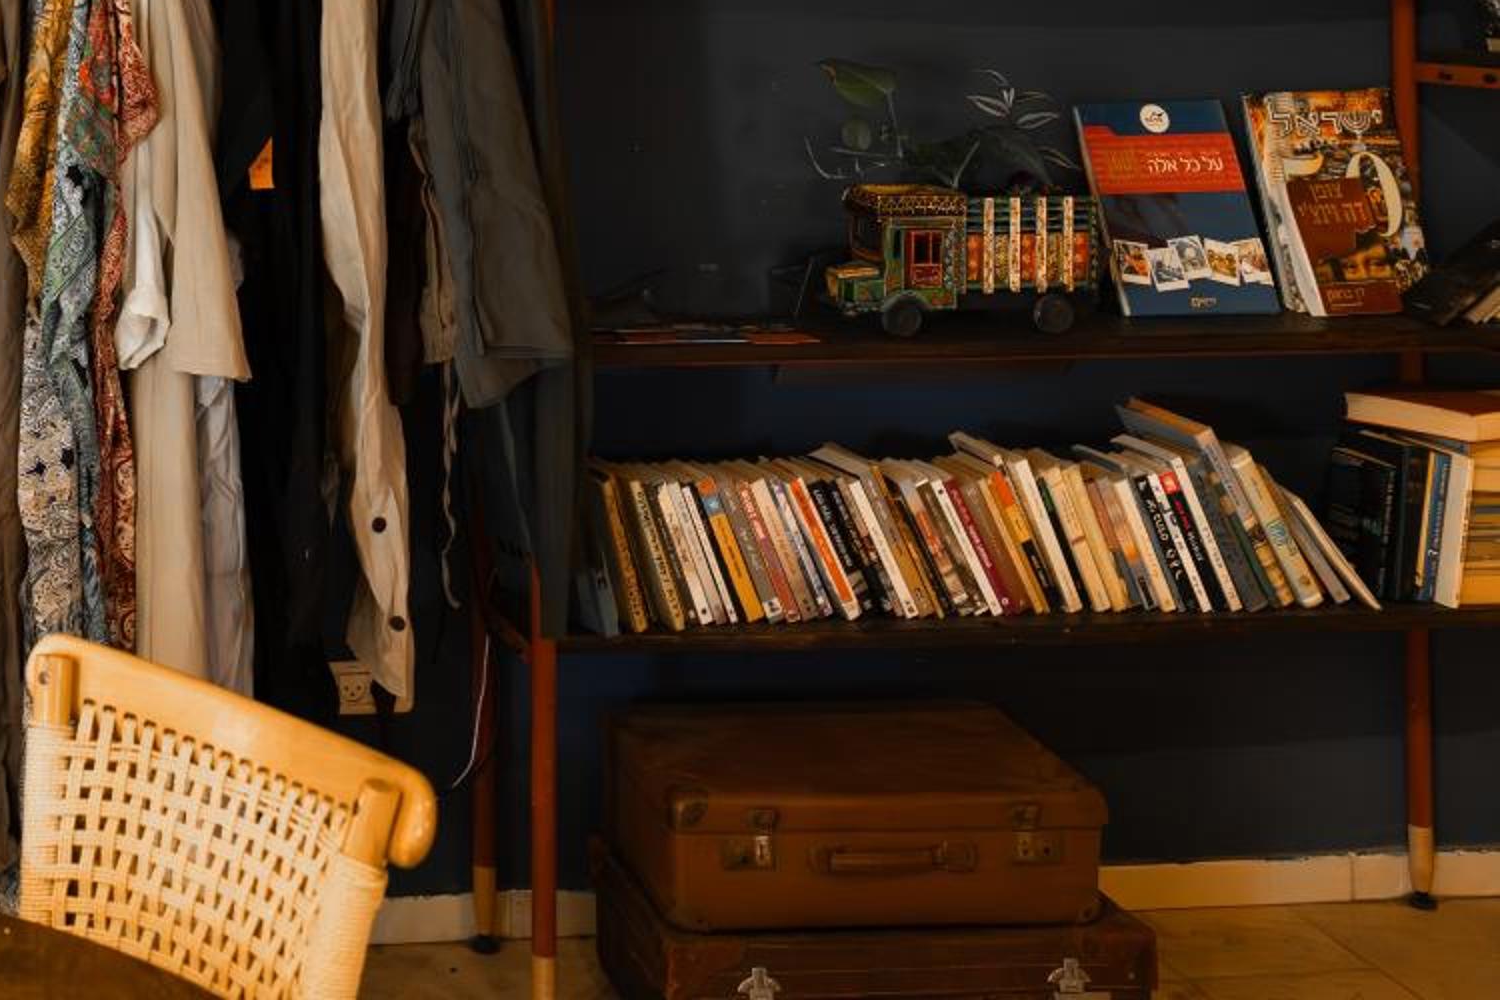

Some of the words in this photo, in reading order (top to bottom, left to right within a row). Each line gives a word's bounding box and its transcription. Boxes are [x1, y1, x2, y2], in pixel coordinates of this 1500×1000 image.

[1269, 106, 1383, 138] ישראל
[1148, 157, 1178, 173] אלה
[1180, 156, 1201, 172] כל
[1202, 156, 1224, 172] על
